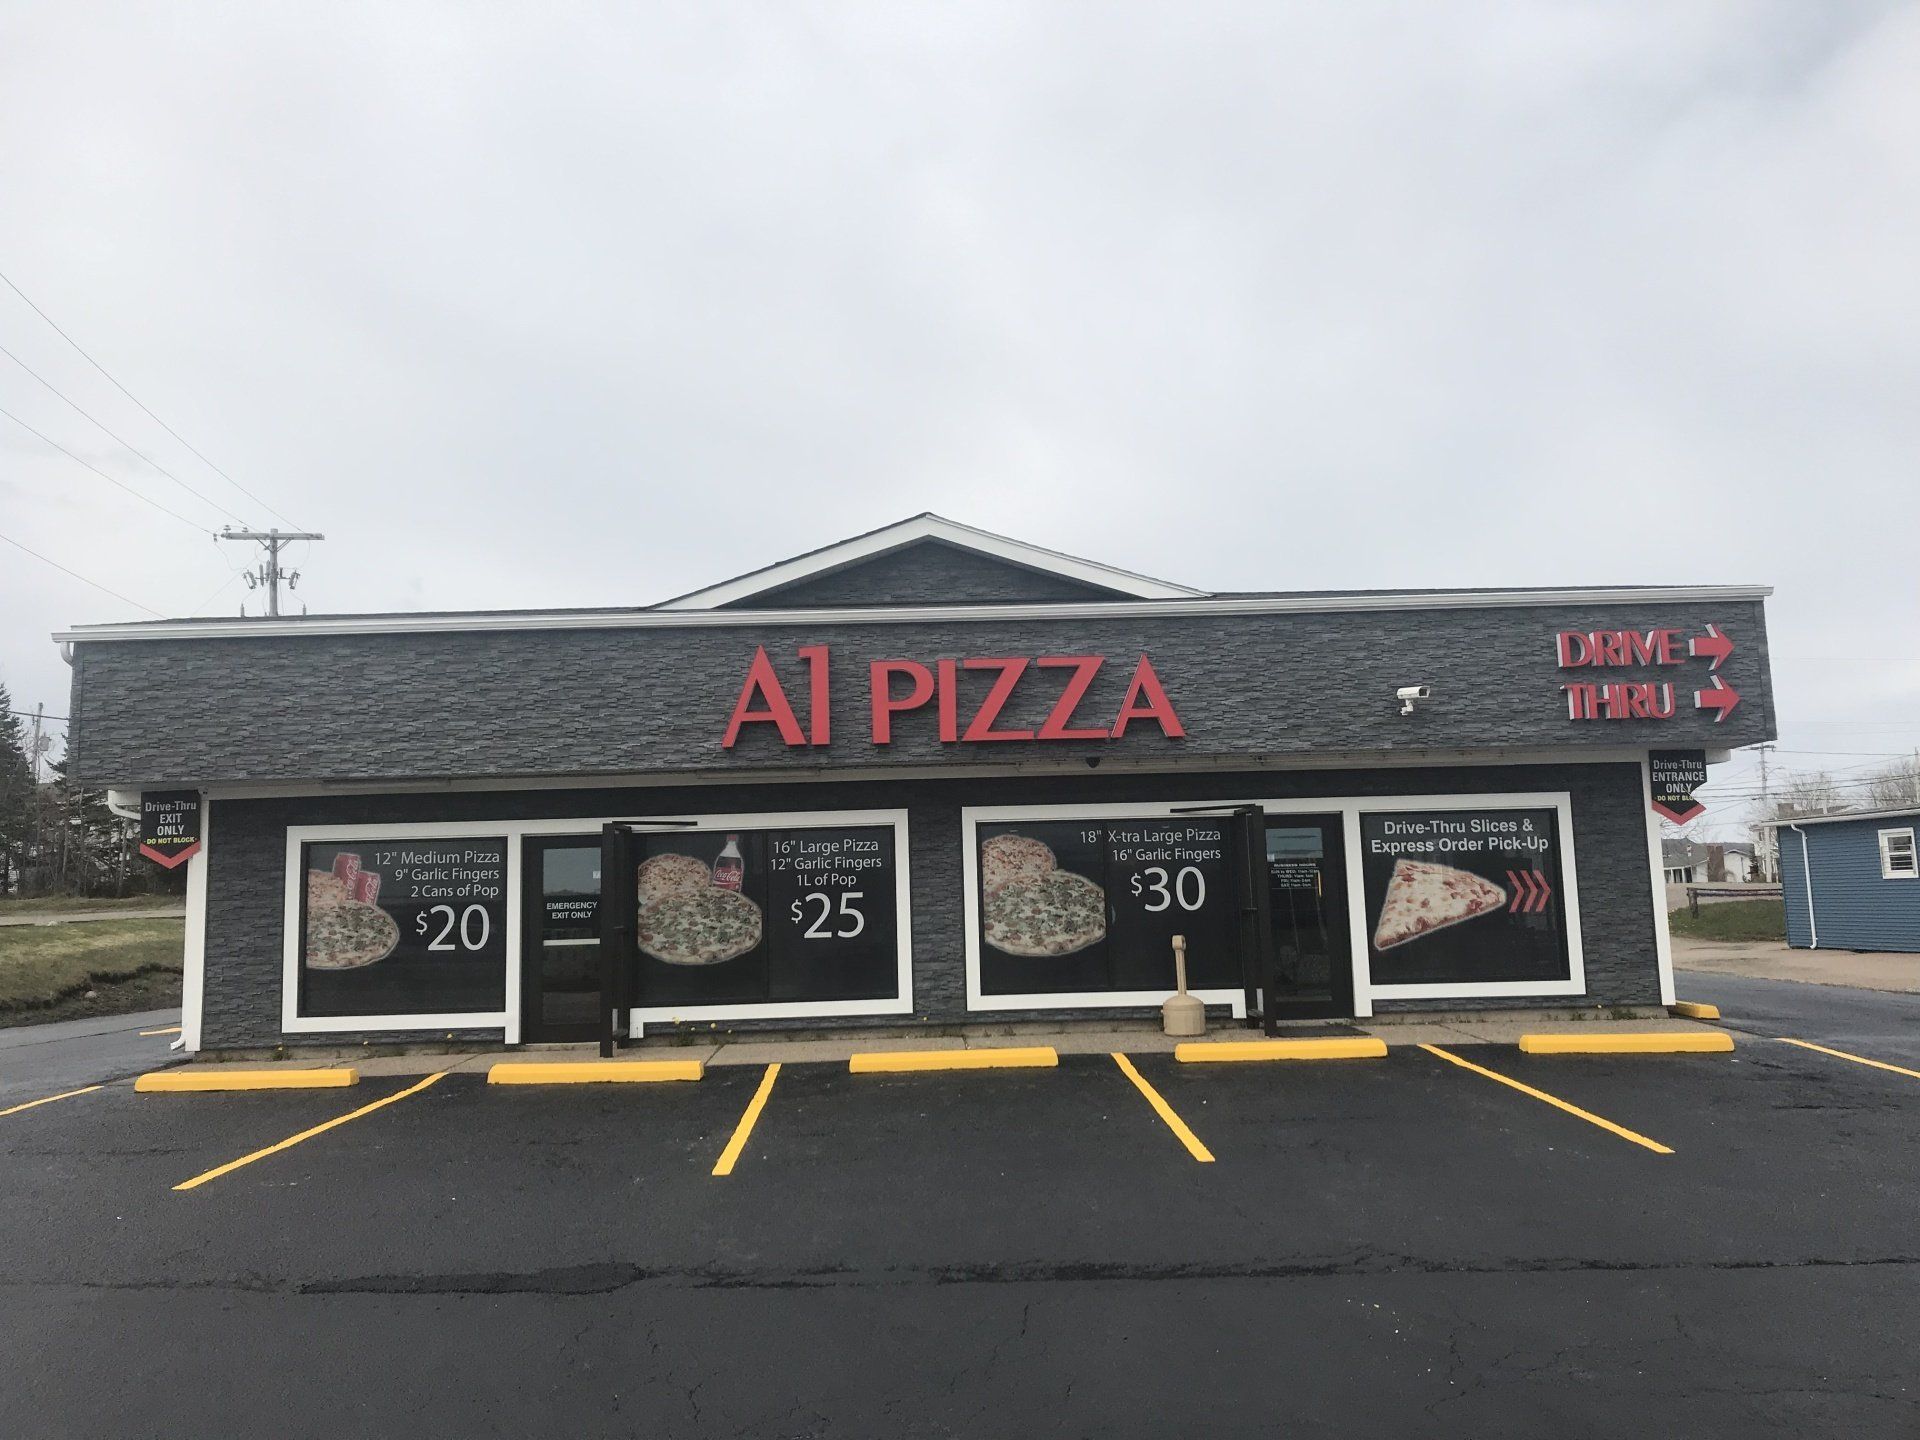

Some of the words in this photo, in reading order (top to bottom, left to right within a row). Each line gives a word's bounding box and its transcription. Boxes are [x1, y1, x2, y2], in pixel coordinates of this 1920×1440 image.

[1556, 628, 1686, 668] DRIVE
[721, 644, 831, 748] A1
[870, 653, 1186, 745] PIZZA
[1560, 681, 1677, 720] THRU
[1653, 760, 1702, 769] Drive-Thru
[1652, 771, 1705, 782] ENTRANCE
[1666, 783, 1692, 793] ONLY
[145, 801, 196, 812] Drive-Thru
[160, 813, 182, 824] EXIT
[157, 825, 185, 836] ONLY
[1384, 820, 1466, 835] Drive-Thru
[1470, 819, 1518, 833] Slices
[1522, 818, 1534, 832] &
[1081, 830, 1102, 843] 18"
[1108, 830, 1140, 843] X-tra
[1144, 829, 1182, 845] Large
[1186, 828, 1221, 841] Pizza
[774, 840, 796, 854] 16"
[800, 840, 840, 856] Large
[843, 838, 879, 852] Pizza
[1371, 839, 1435, 856] Express
[1438, 838, 1484, 852] Order
[1488, 835, 1548, 853] Pick-Up
[375, 851, 397, 865] 12"
[401, 851, 460, 864] Medium
[464, 850, 500, 863] Pizza
[1112, 849, 1132, 861] 16"
[1136, 848, 1172, 861] Garlic
[1175, 848, 1221, 862] Fingers
[771, 858, 791, 870] 12"
[794, 857, 832, 870] Garlic
[835, 856, 882, 871] Fingers
[395, 868, 408, 881] 9"
[411, 868, 449, 881] Garlic
[452, 868, 500, 883] Fingers
[797, 874, 811, 886] 1L
[814, 873, 829, 886] of
[831, 873, 857, 887] Pop
[411, 886, 419, 898] 2
[422, 885, 453, 897] Cans
[457, 884, 471, 897] of
[473, 884, 499, 898] Pop
[1130, 866, 1206, 912] $30
[546, 901, 598, 910] EMERGENCY
[552, 911, 569, 919] EXIT
[571, 911, 593, 919] ONLY
[791, 891, 865, 939] $25
[416, 904, 490, 951] $20
